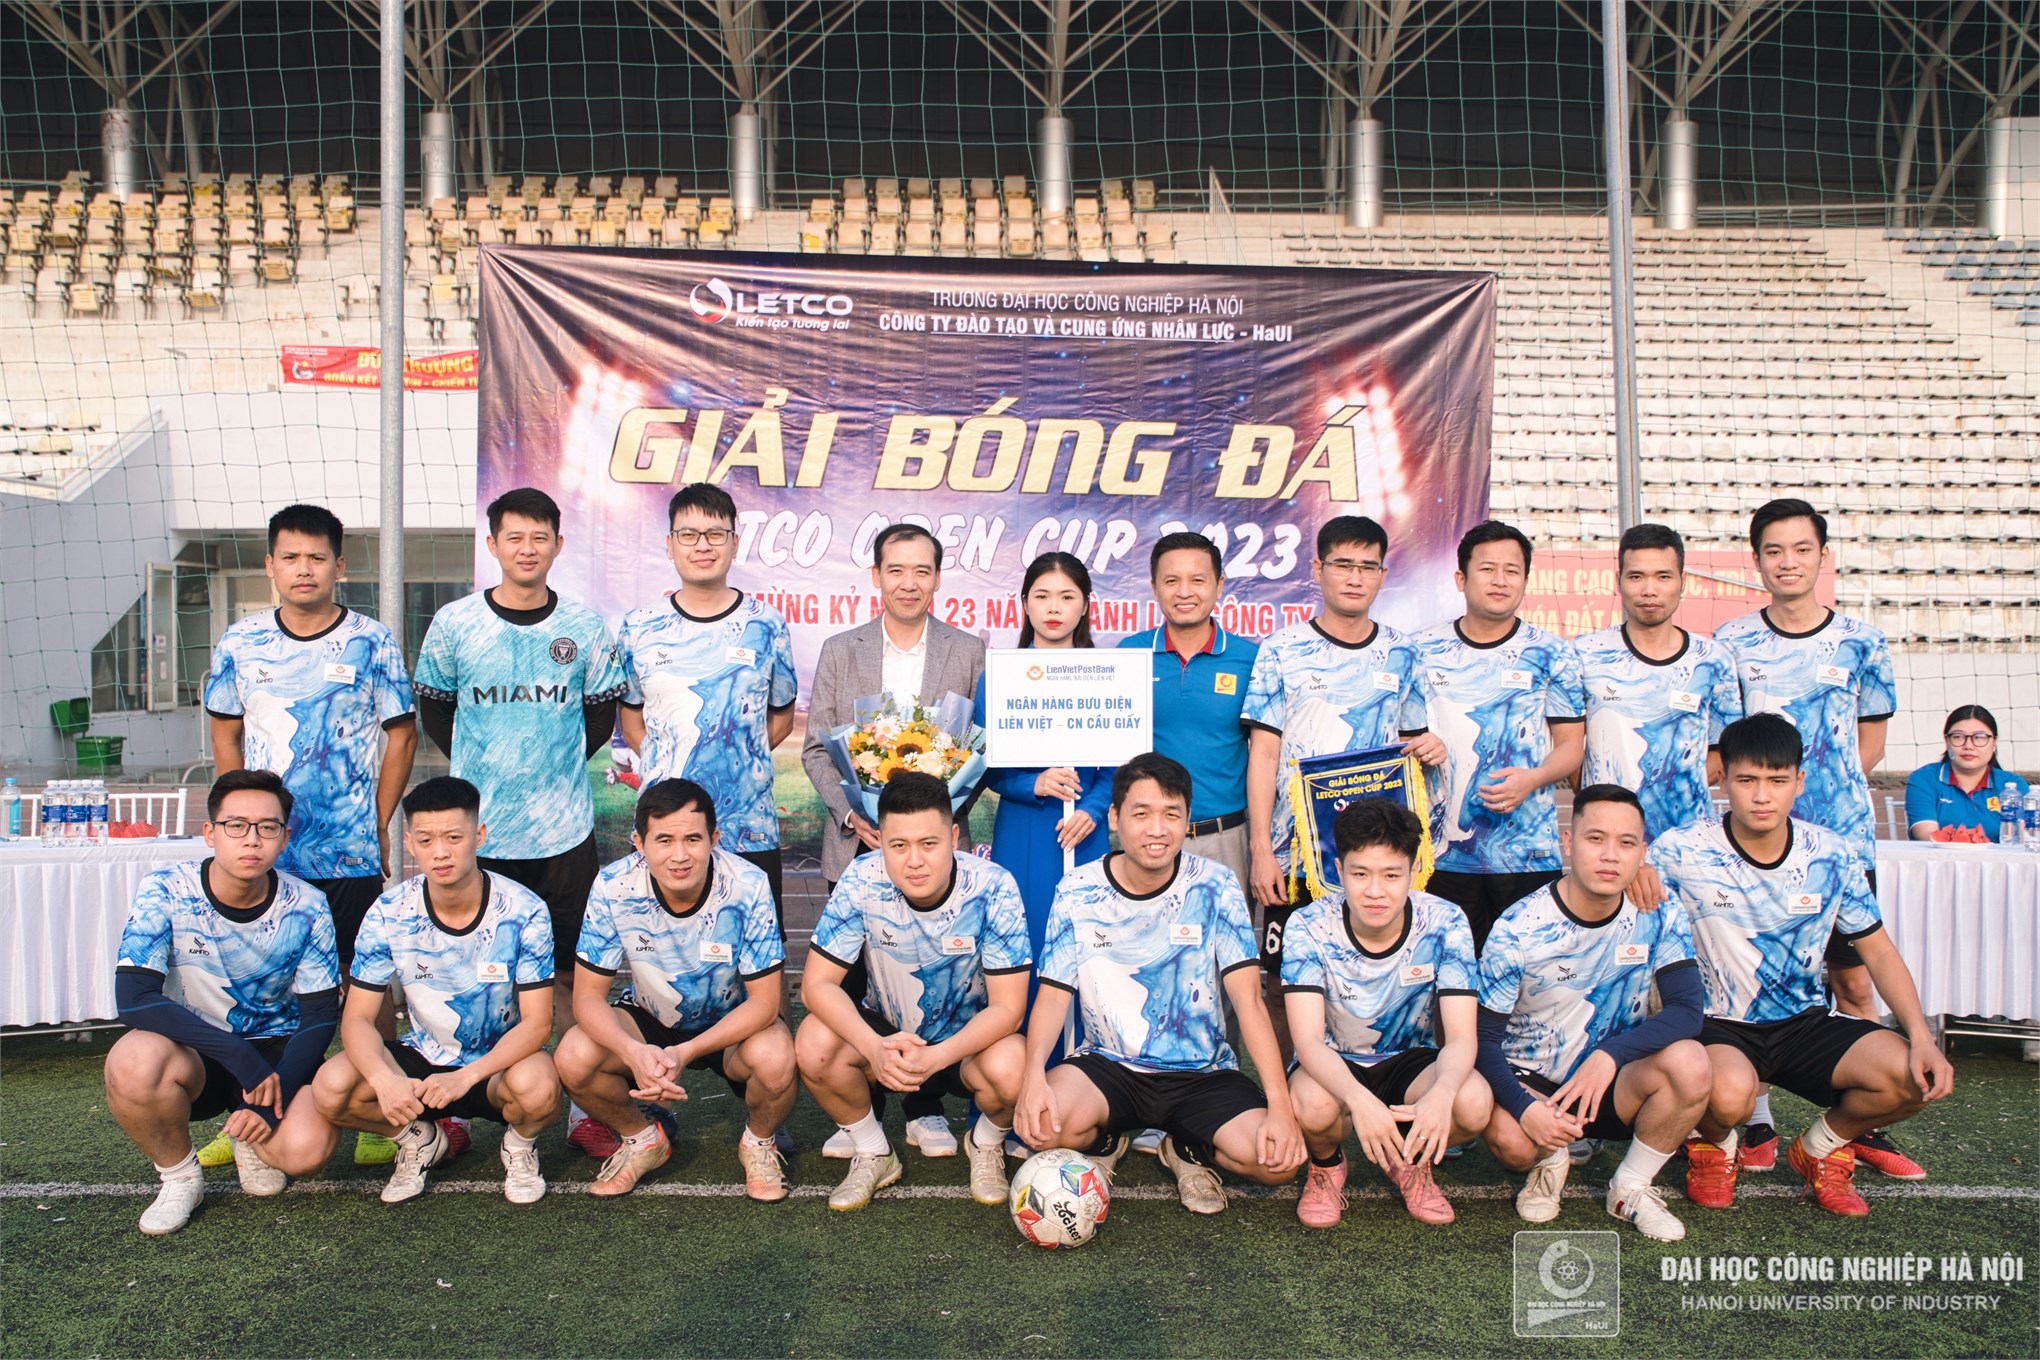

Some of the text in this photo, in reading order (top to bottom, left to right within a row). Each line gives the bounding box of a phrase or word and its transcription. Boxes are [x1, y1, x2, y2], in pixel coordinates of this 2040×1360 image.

[736, 292, 853, 316] LETCO
[932, 289, 1243, 318] TRƯỜNG ĐẠI HỌC CÔNG NGHIỆP HÀ NỘI
[735, 315, 763, 328] Kiến
[833, 319, 850, 330] lai
[879, 311, 926, 331] CÔNG
[931, 316, 951, 332] TY
[955, 313, 990, 333] ĐÀO
[995, 317, 1028, 337] TẠO
[1032, 315, 1055, 335] VÀ
[1060, 319, 1106, 337] CUNG
[1112, 317, 1146, 337] ỨNG
[1152, 319, 1197, 339] NHÂN
[1202, 321, 1234, 343] LỰC
[1252, 324, 1292, 342] HaUI
[608, 387, 1367, 502] GIẢI BÓNG ĐÁ
[736, 510, 833, 569] TCO
[850, 511, 1007, 573] OEN
[1574, 569, 1614, 596] CAO
[829, 586, 861, 625] KỶ
[945, 597, 976, 628] 23
[986, 592, 1024, 629] NĂ
[472, 685, 568, 705] MIAMI
[1006, 696, 1132, 712] NGÂN HÀNG BƯU ĐIỆN
[998, 716, 1023, 730] LIÊN
[1028, 715, 1053, 732] VIỆT
[1067, 718, 1083, 730] CN
[1114, 714, 1141, 730] GIẤY
[1316, 779, 1403, 800] LETCO OPEN CUP 2023
[1328, 771, 1386, 788] GIẢI BÓNG ĐÁ
[1265, 920, 1281, 955] 6
[1052, 1201, 1082, 1241] zocker
